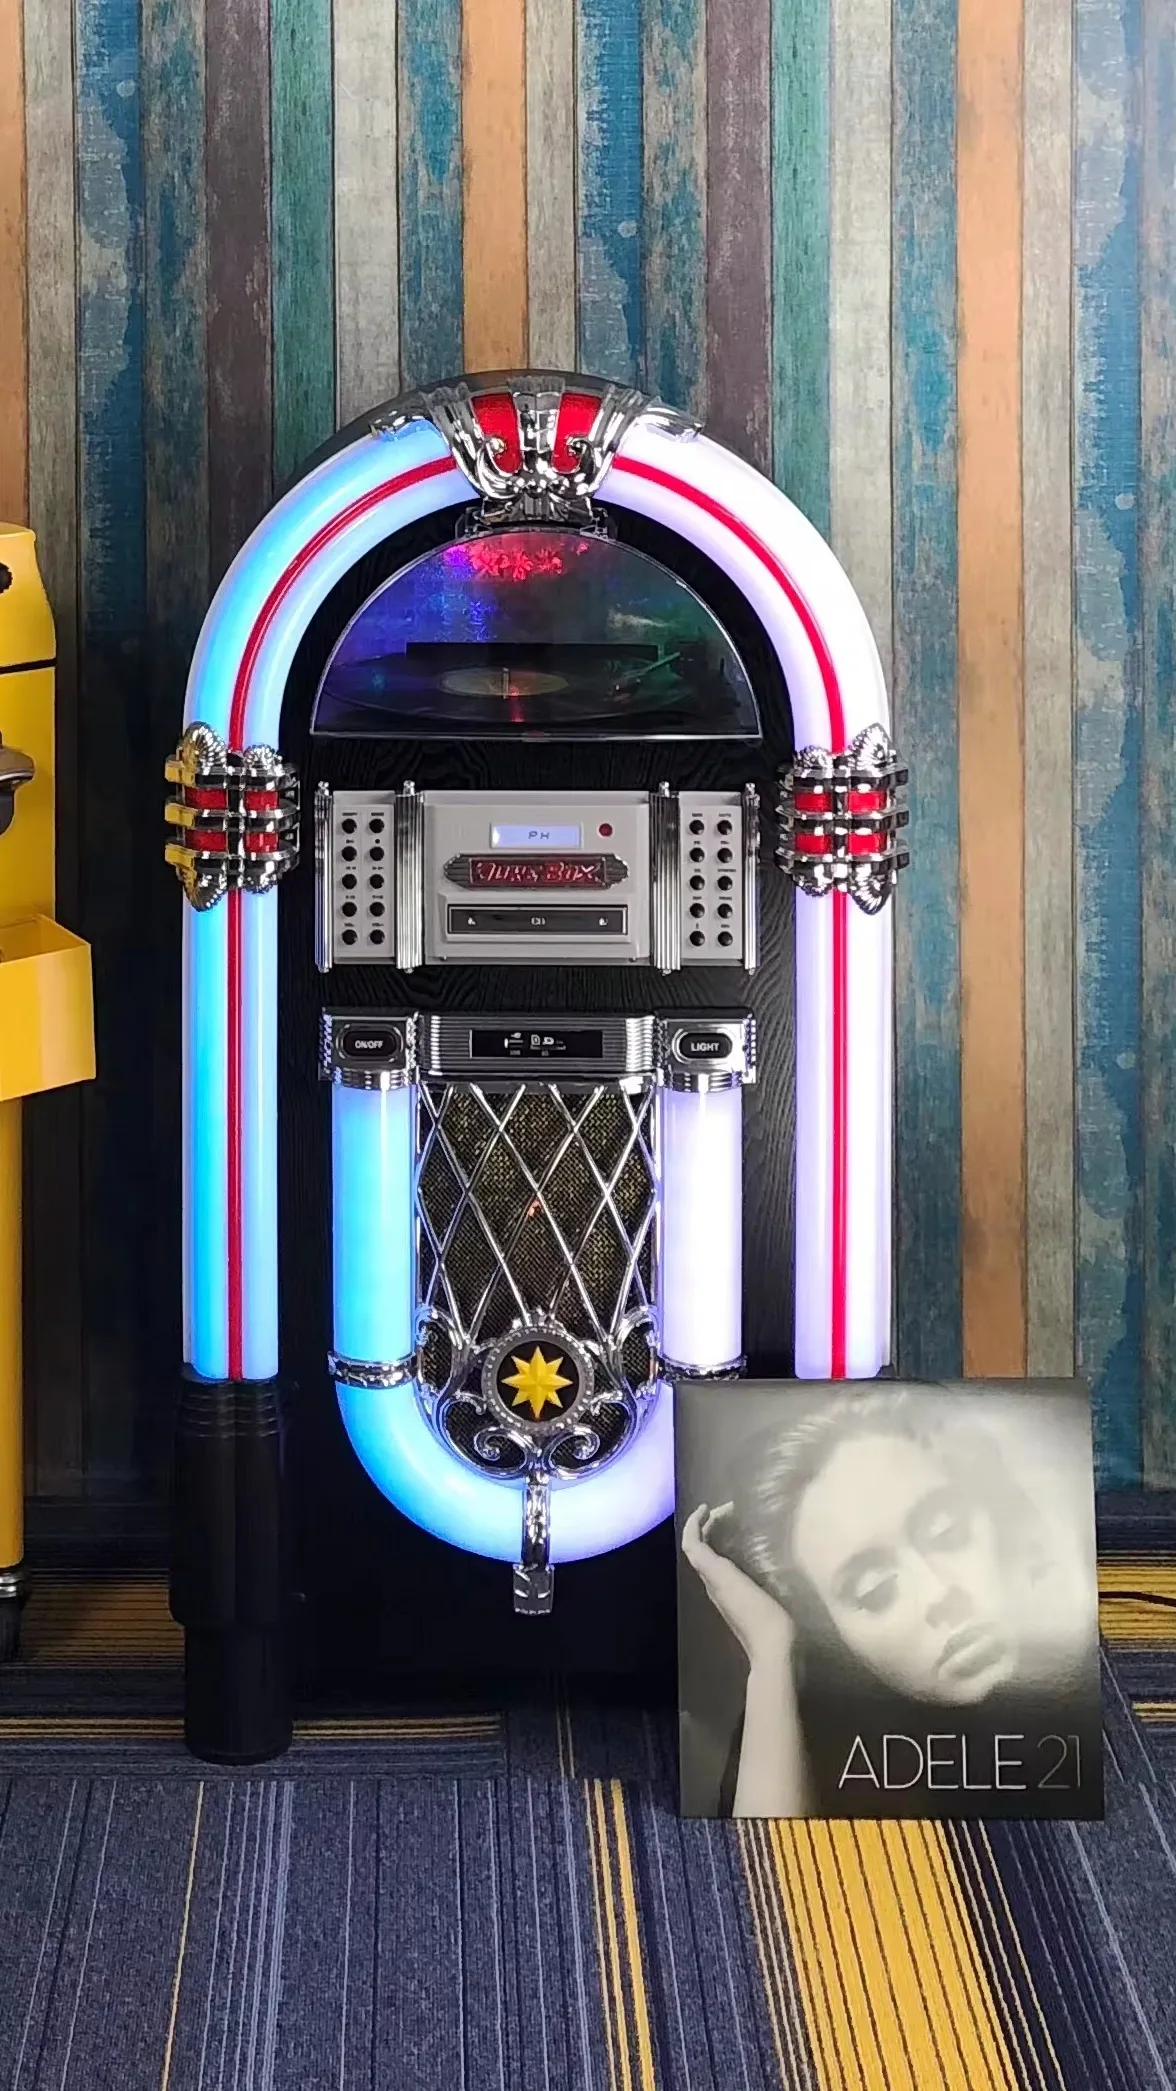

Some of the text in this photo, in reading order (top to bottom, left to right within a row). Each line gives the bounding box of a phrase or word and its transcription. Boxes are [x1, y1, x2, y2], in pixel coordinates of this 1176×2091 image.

[354, 1040, 384, 1049] ON/OFF
[690, 1042, 720, 1052] LIGHT
[838, 1733, 1081, 1790] ADELE 21
